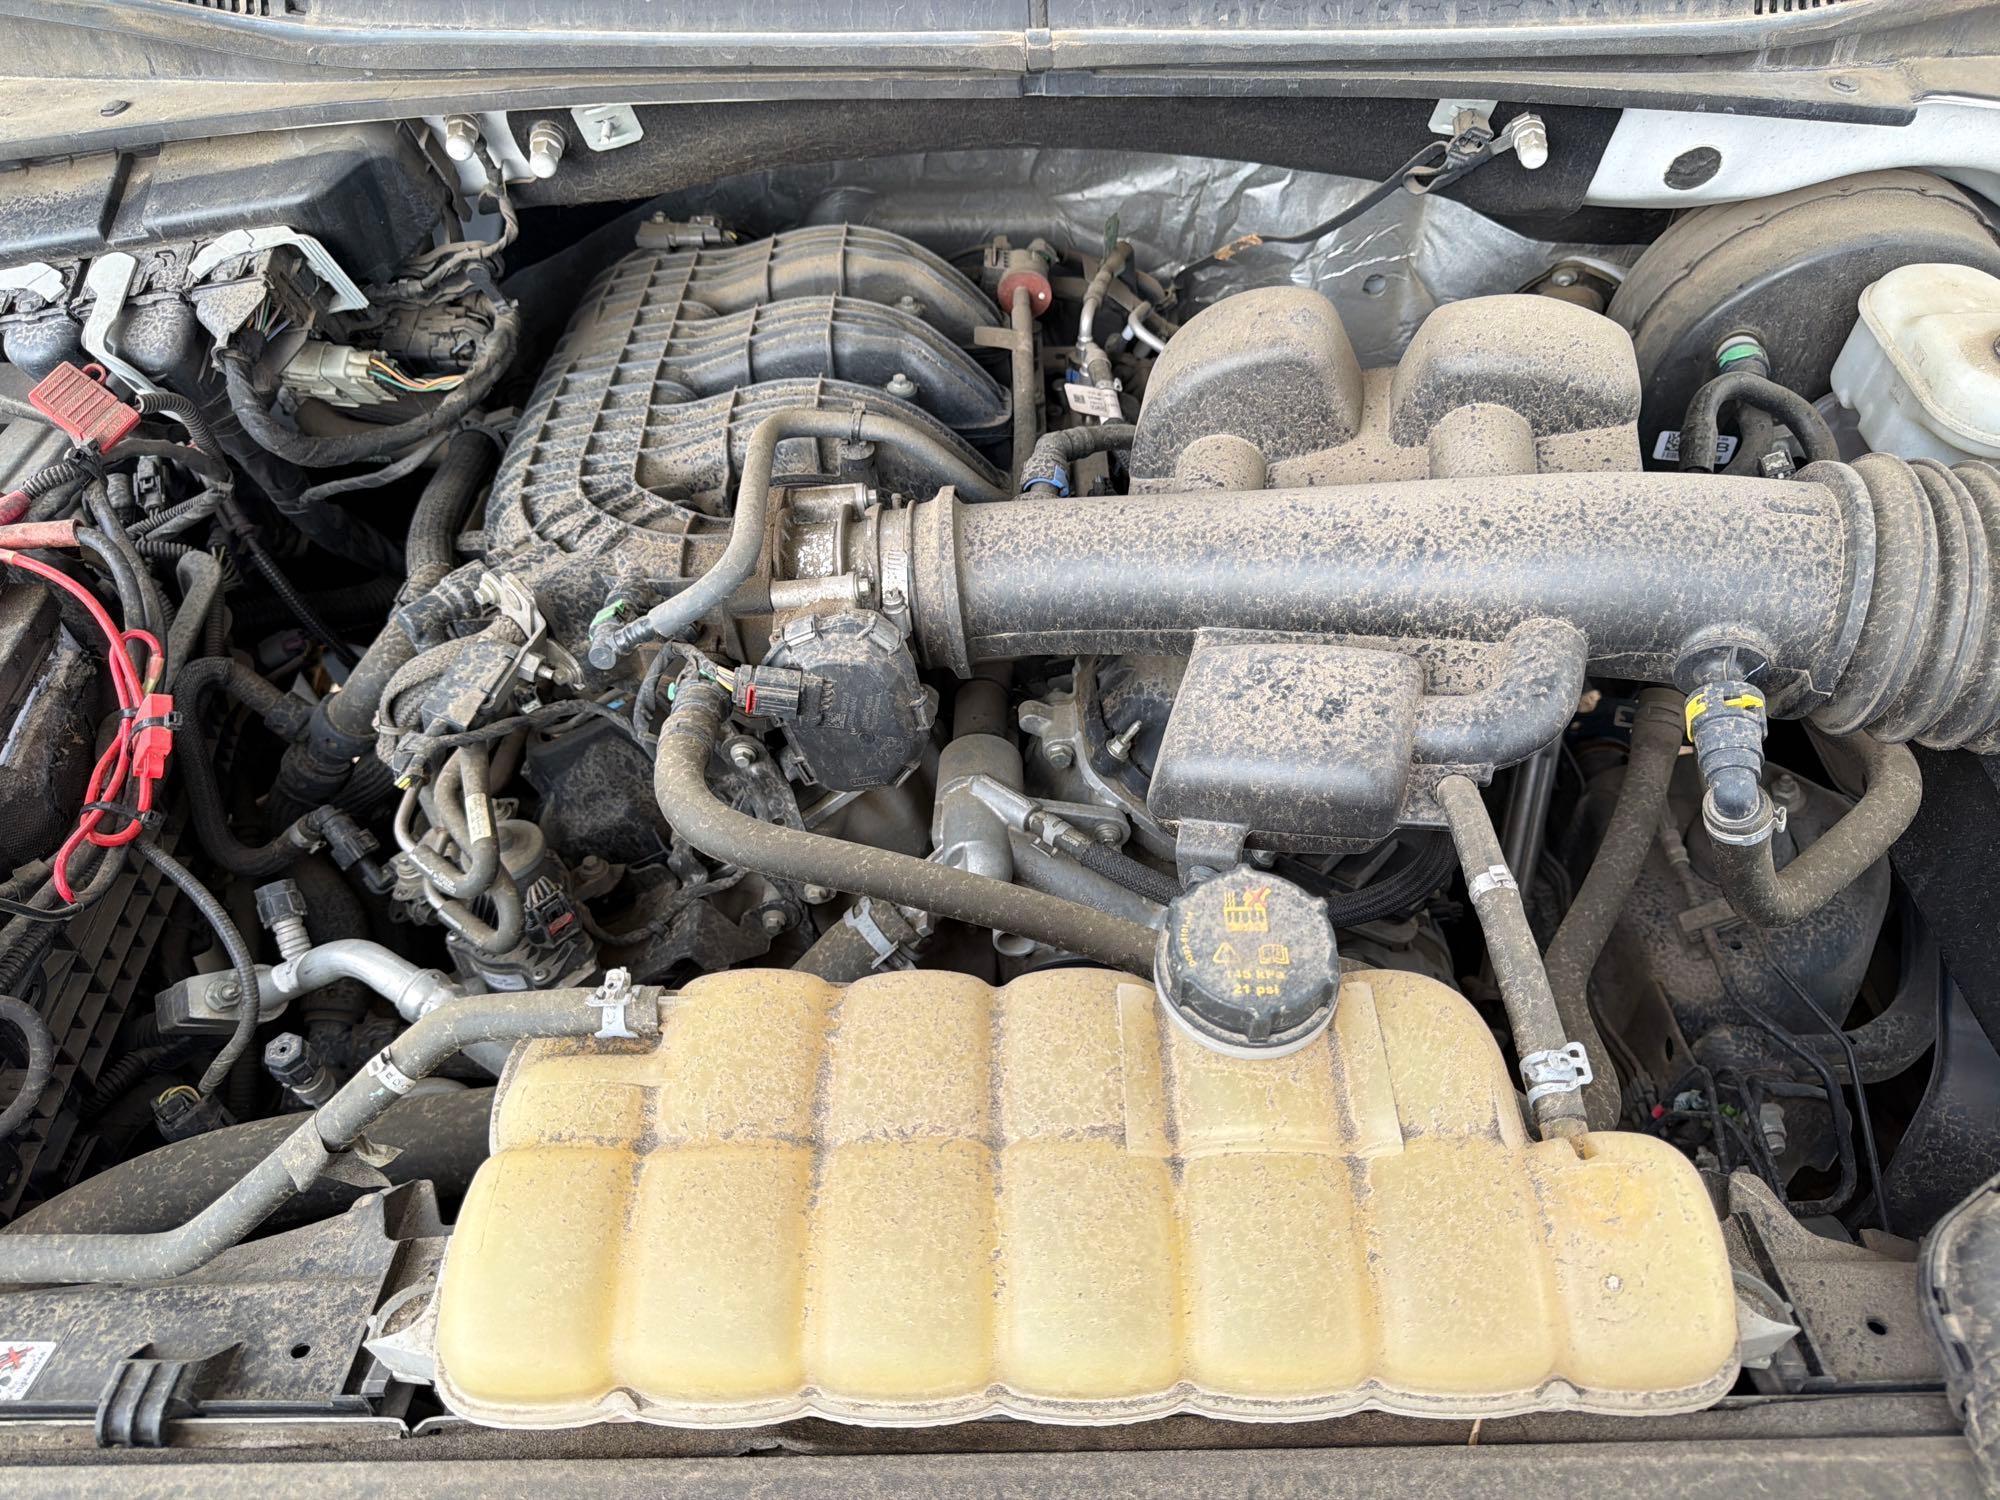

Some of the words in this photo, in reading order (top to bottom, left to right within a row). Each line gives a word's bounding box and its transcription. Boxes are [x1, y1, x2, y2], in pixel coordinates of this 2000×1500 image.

[1256, 968, 1285, 979] kPa
[1232, 984, 1251, 995] 21
[1256, 984, 1281, 997] psi
